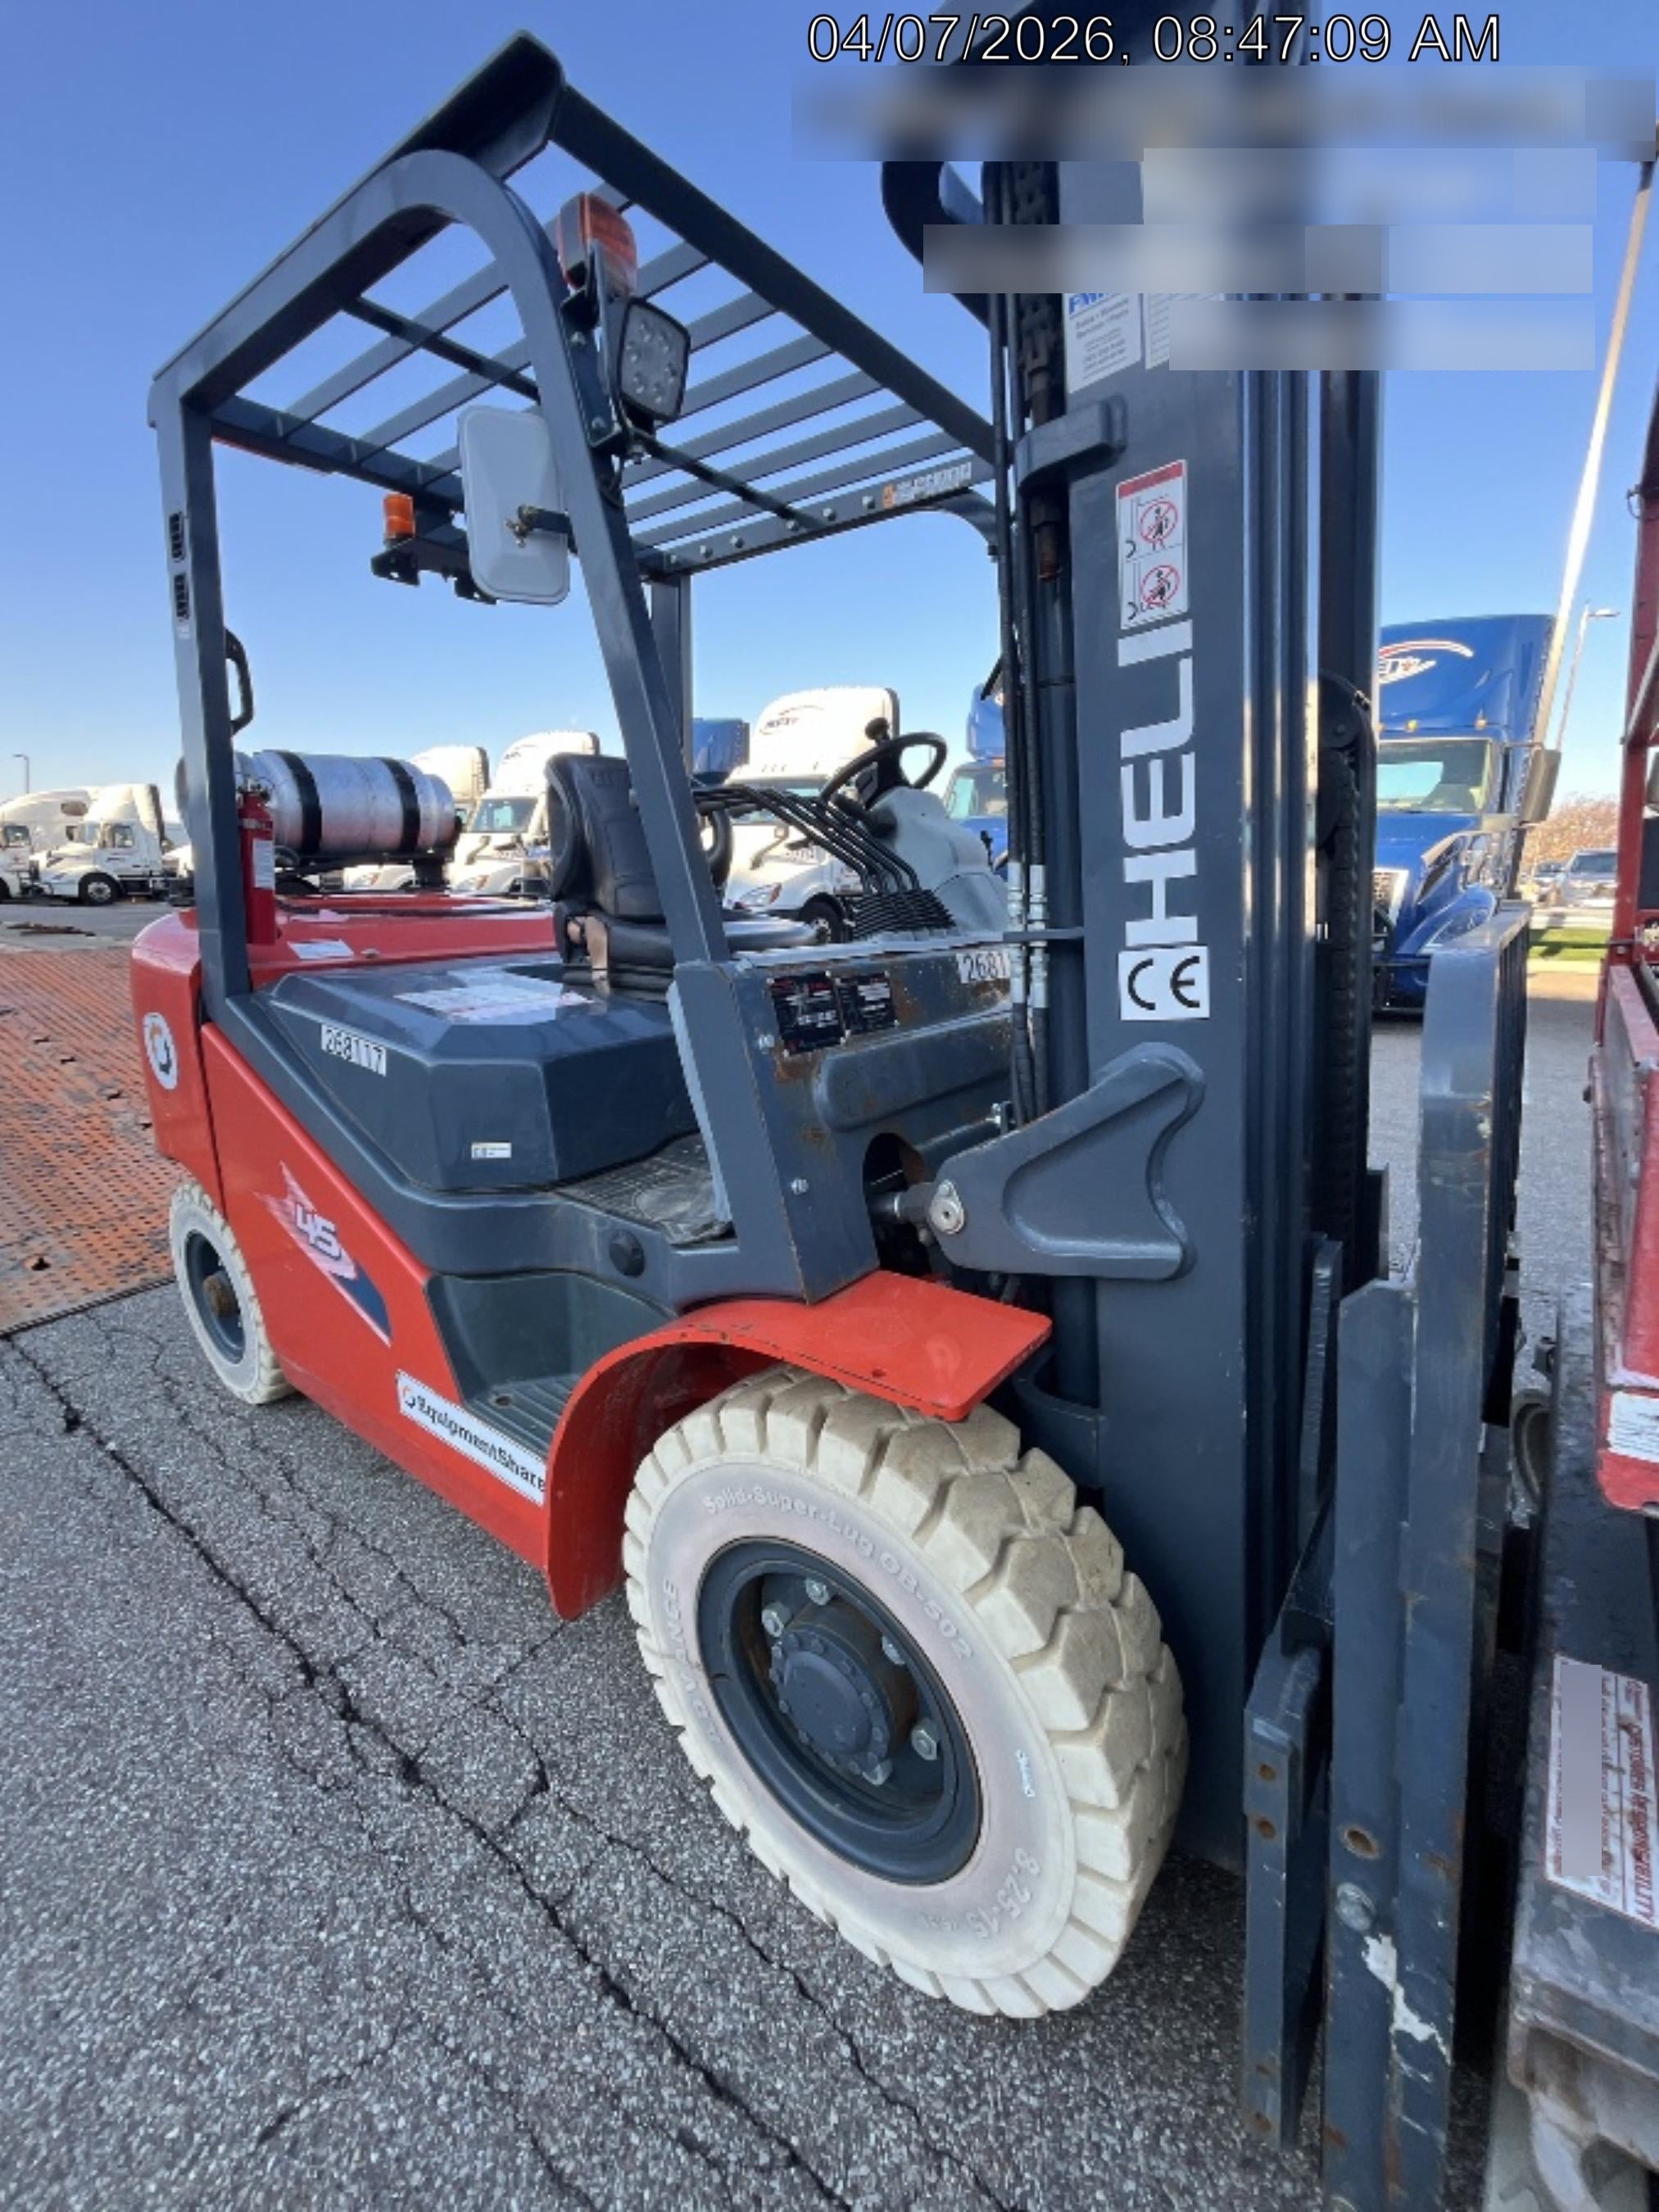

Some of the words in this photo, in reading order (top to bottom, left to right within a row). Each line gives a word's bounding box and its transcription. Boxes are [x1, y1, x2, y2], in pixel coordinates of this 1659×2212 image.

[1117, 619, 1199, 947] HELI
[1127, 956, 1201, 1011] CE
[417, 1395, 547, 1493] EquipmentShare
